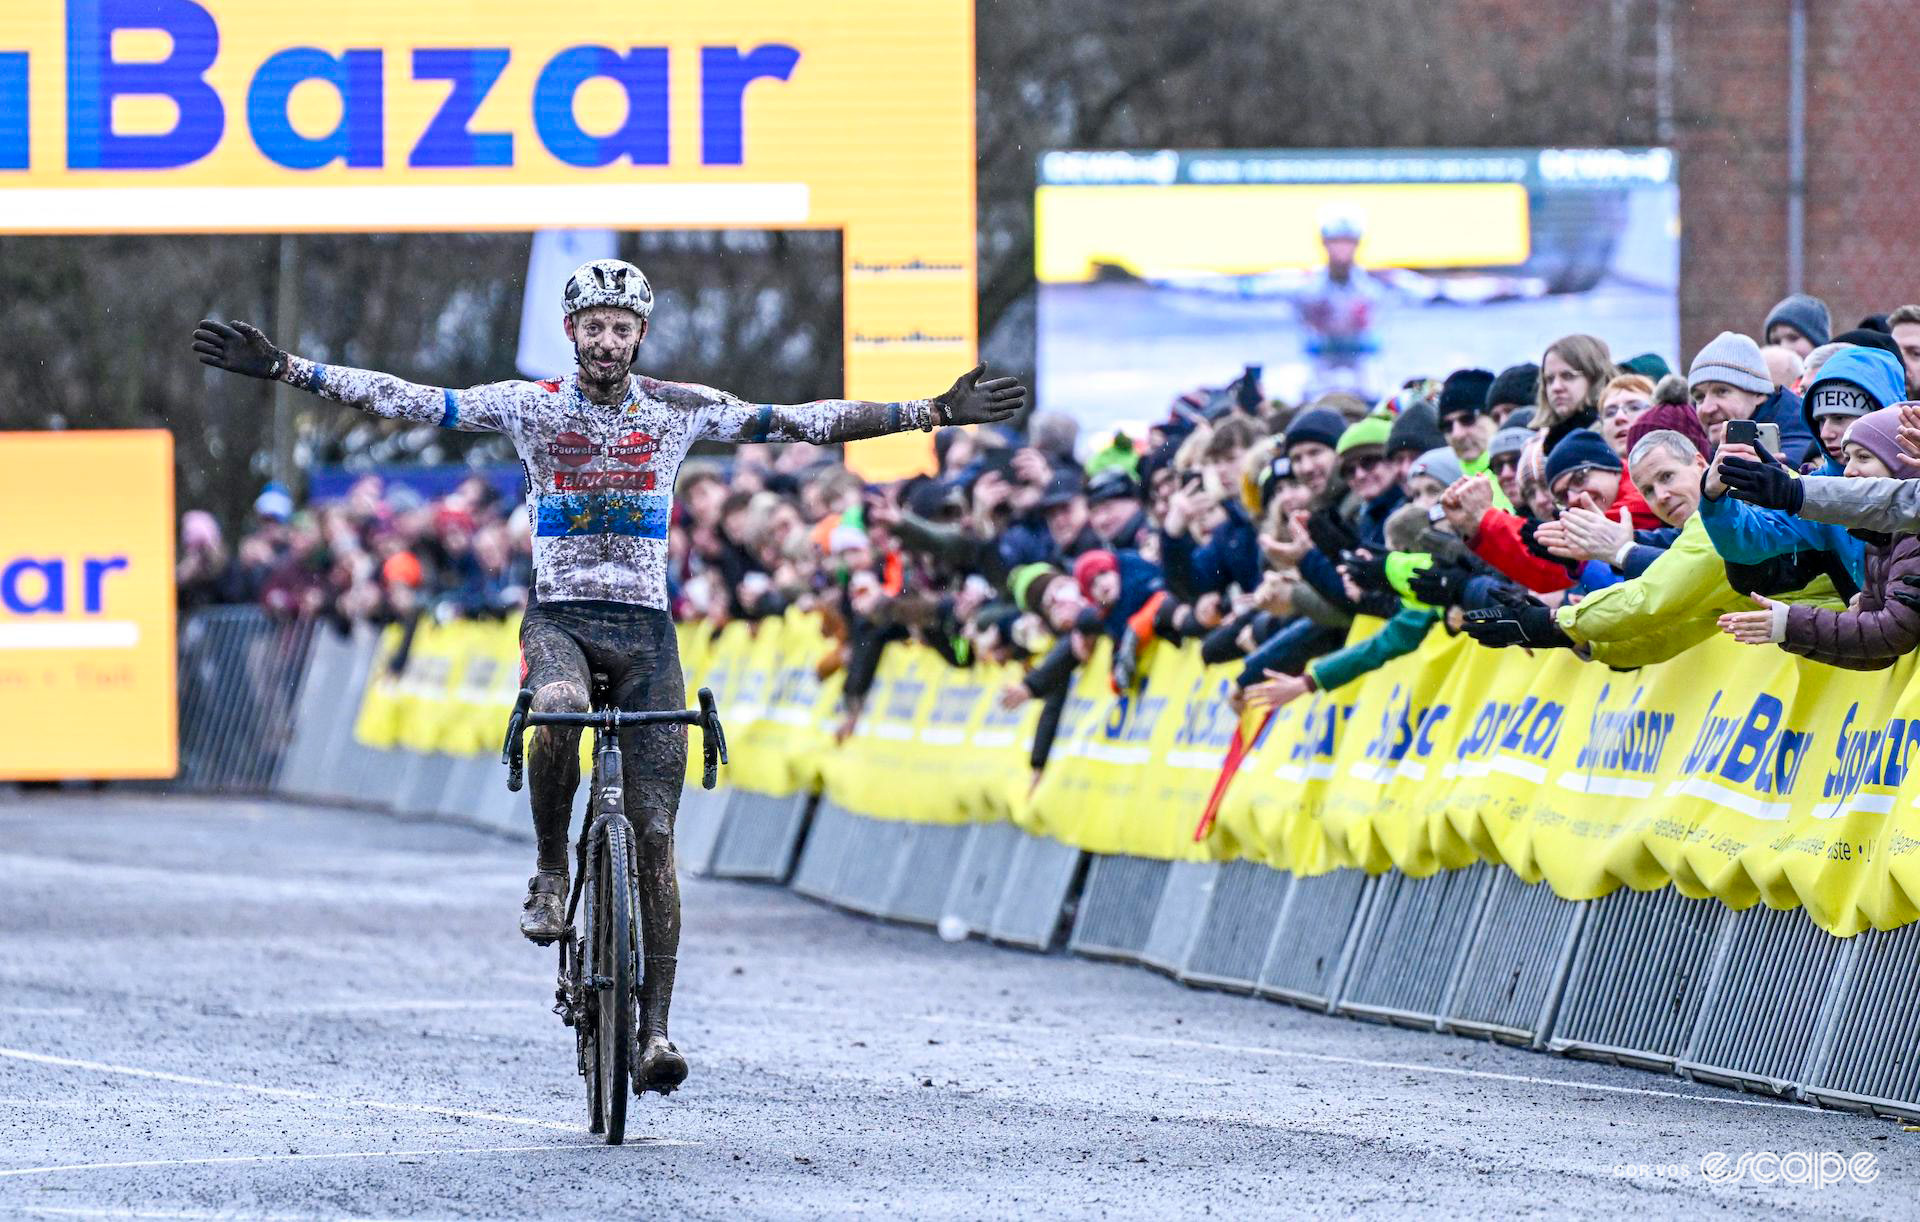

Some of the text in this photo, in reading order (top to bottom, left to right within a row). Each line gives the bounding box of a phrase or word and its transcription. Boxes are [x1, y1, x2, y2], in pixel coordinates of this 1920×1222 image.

[0, 0, 801, 171] Bazar
[1816, 390, 1872, 410] TERYX
[611, 441, 658, 456] Pauwels
